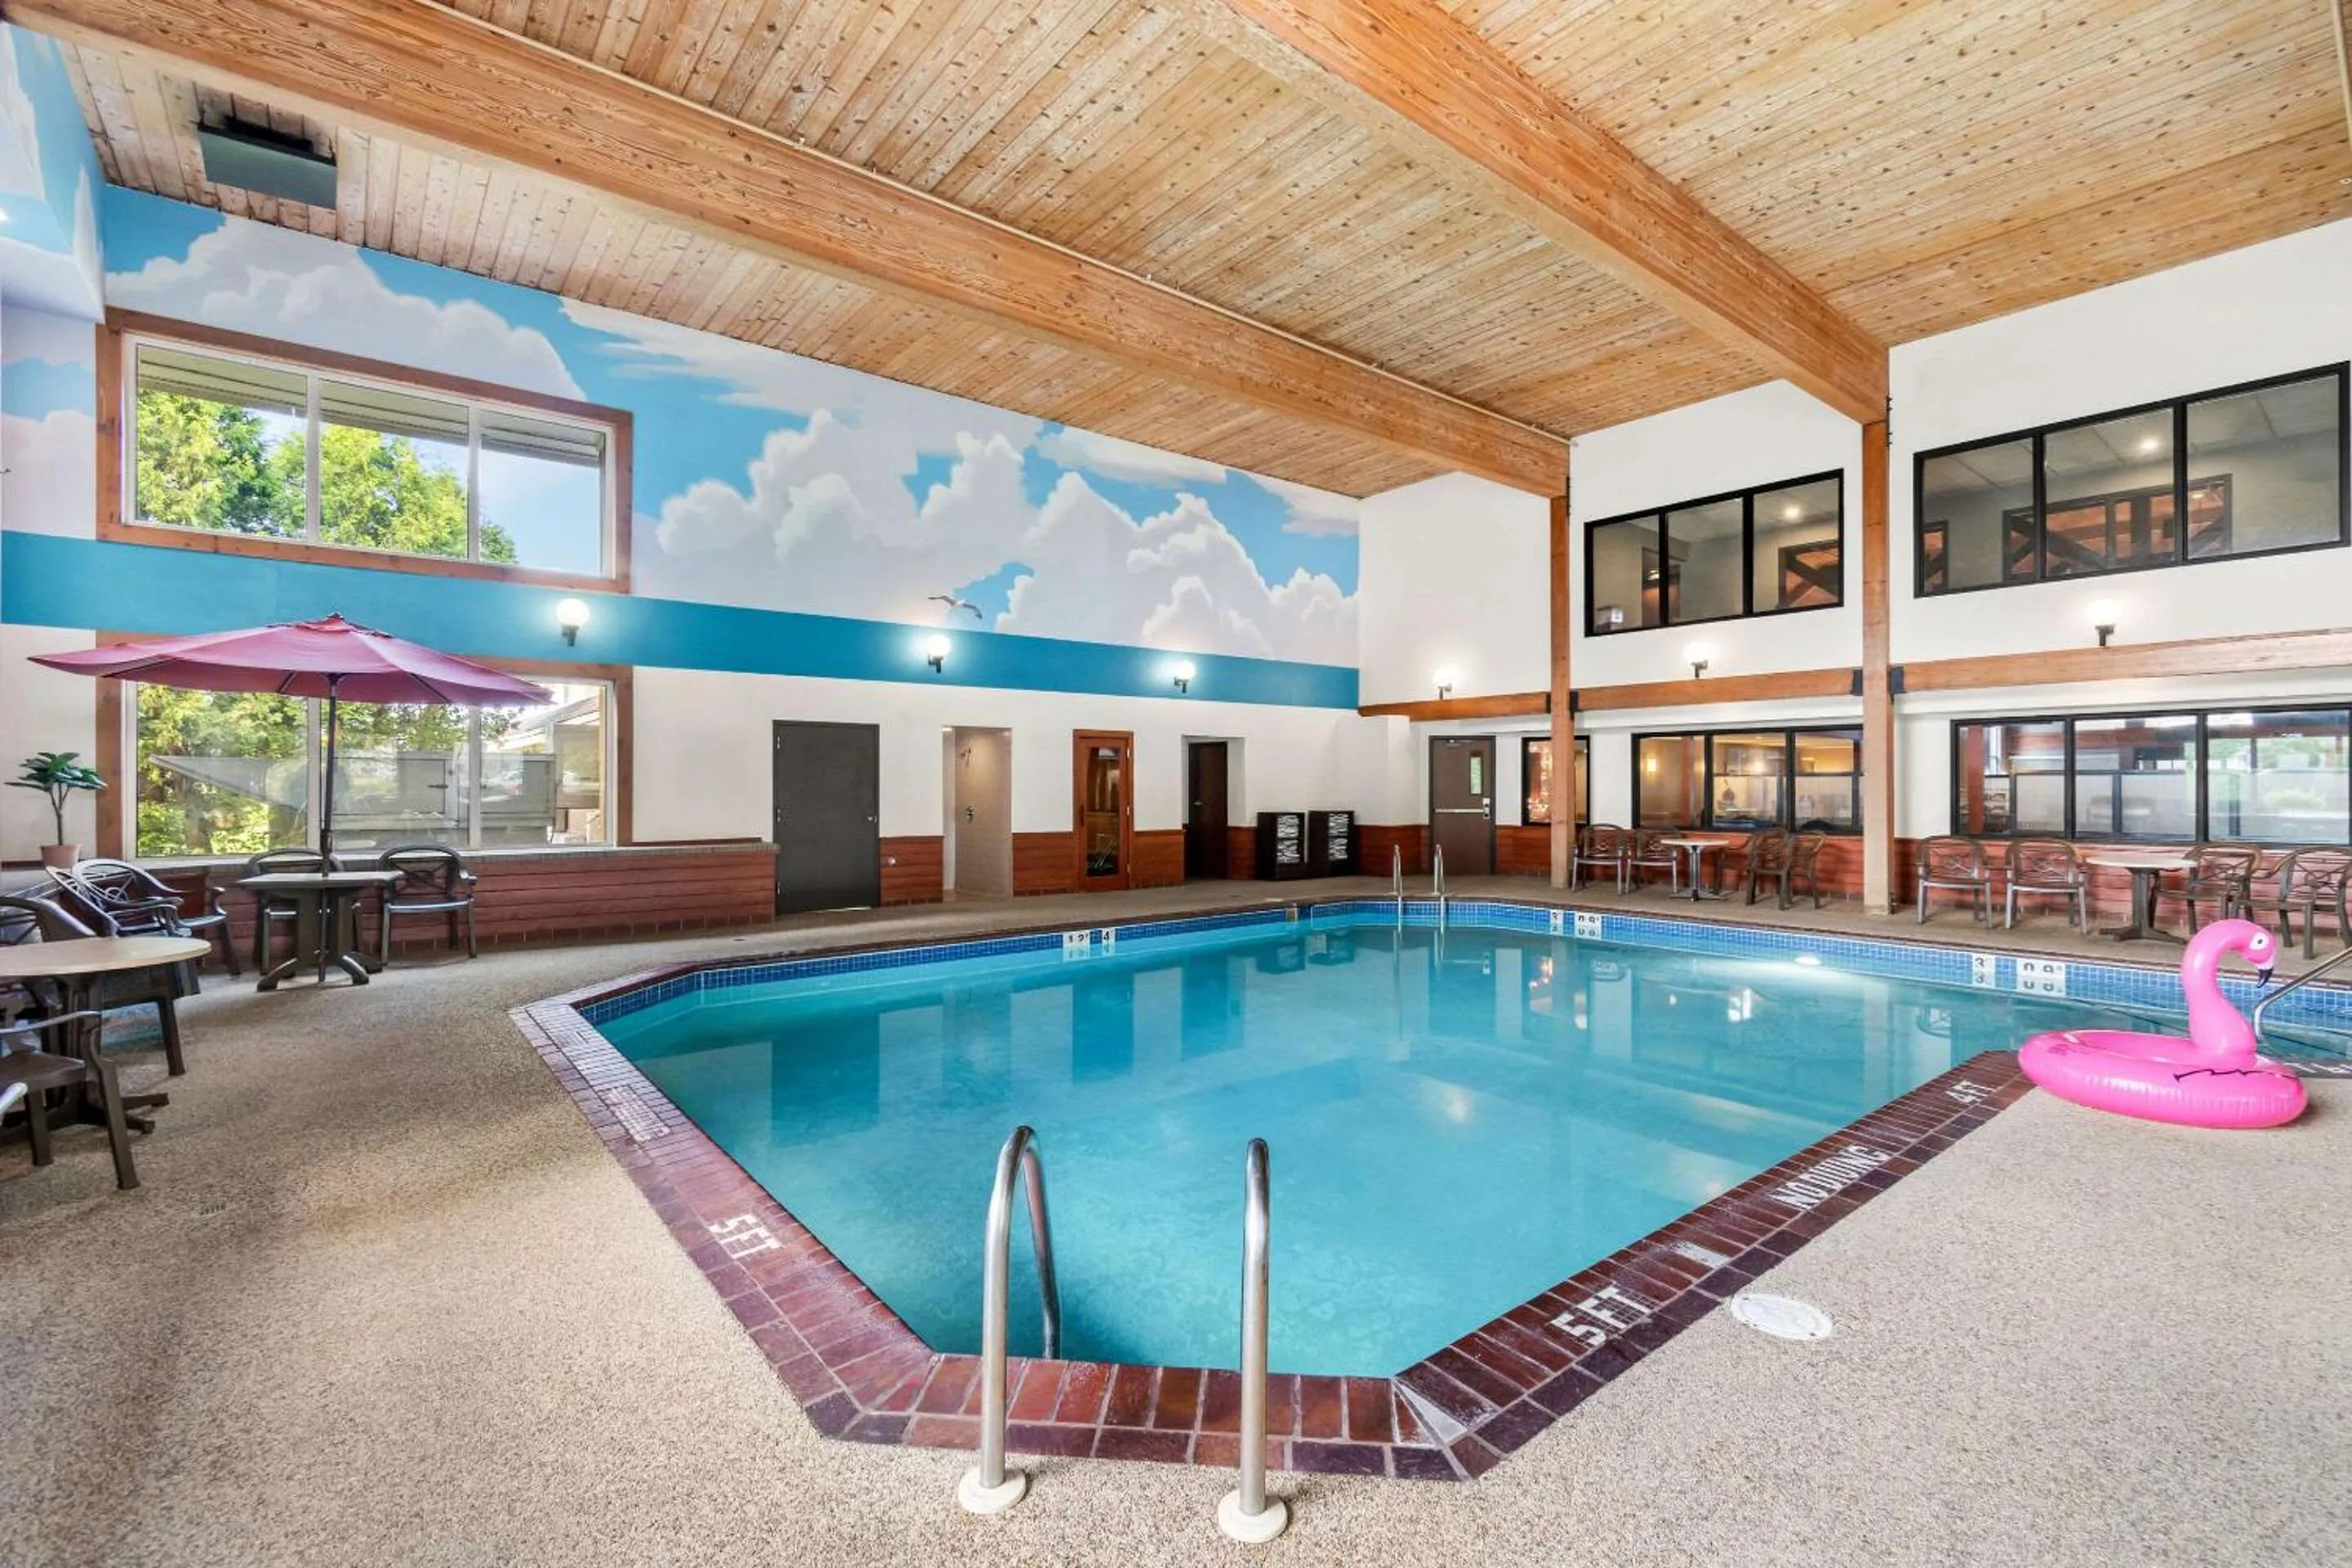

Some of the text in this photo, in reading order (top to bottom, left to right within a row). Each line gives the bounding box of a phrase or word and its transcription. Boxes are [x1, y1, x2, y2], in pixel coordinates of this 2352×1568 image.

[1766, 1180, 1829, 1209] NO
[709, 1213, 782, 1259] 5FT
[1550, 1285, 1652, 1347] 5FT
